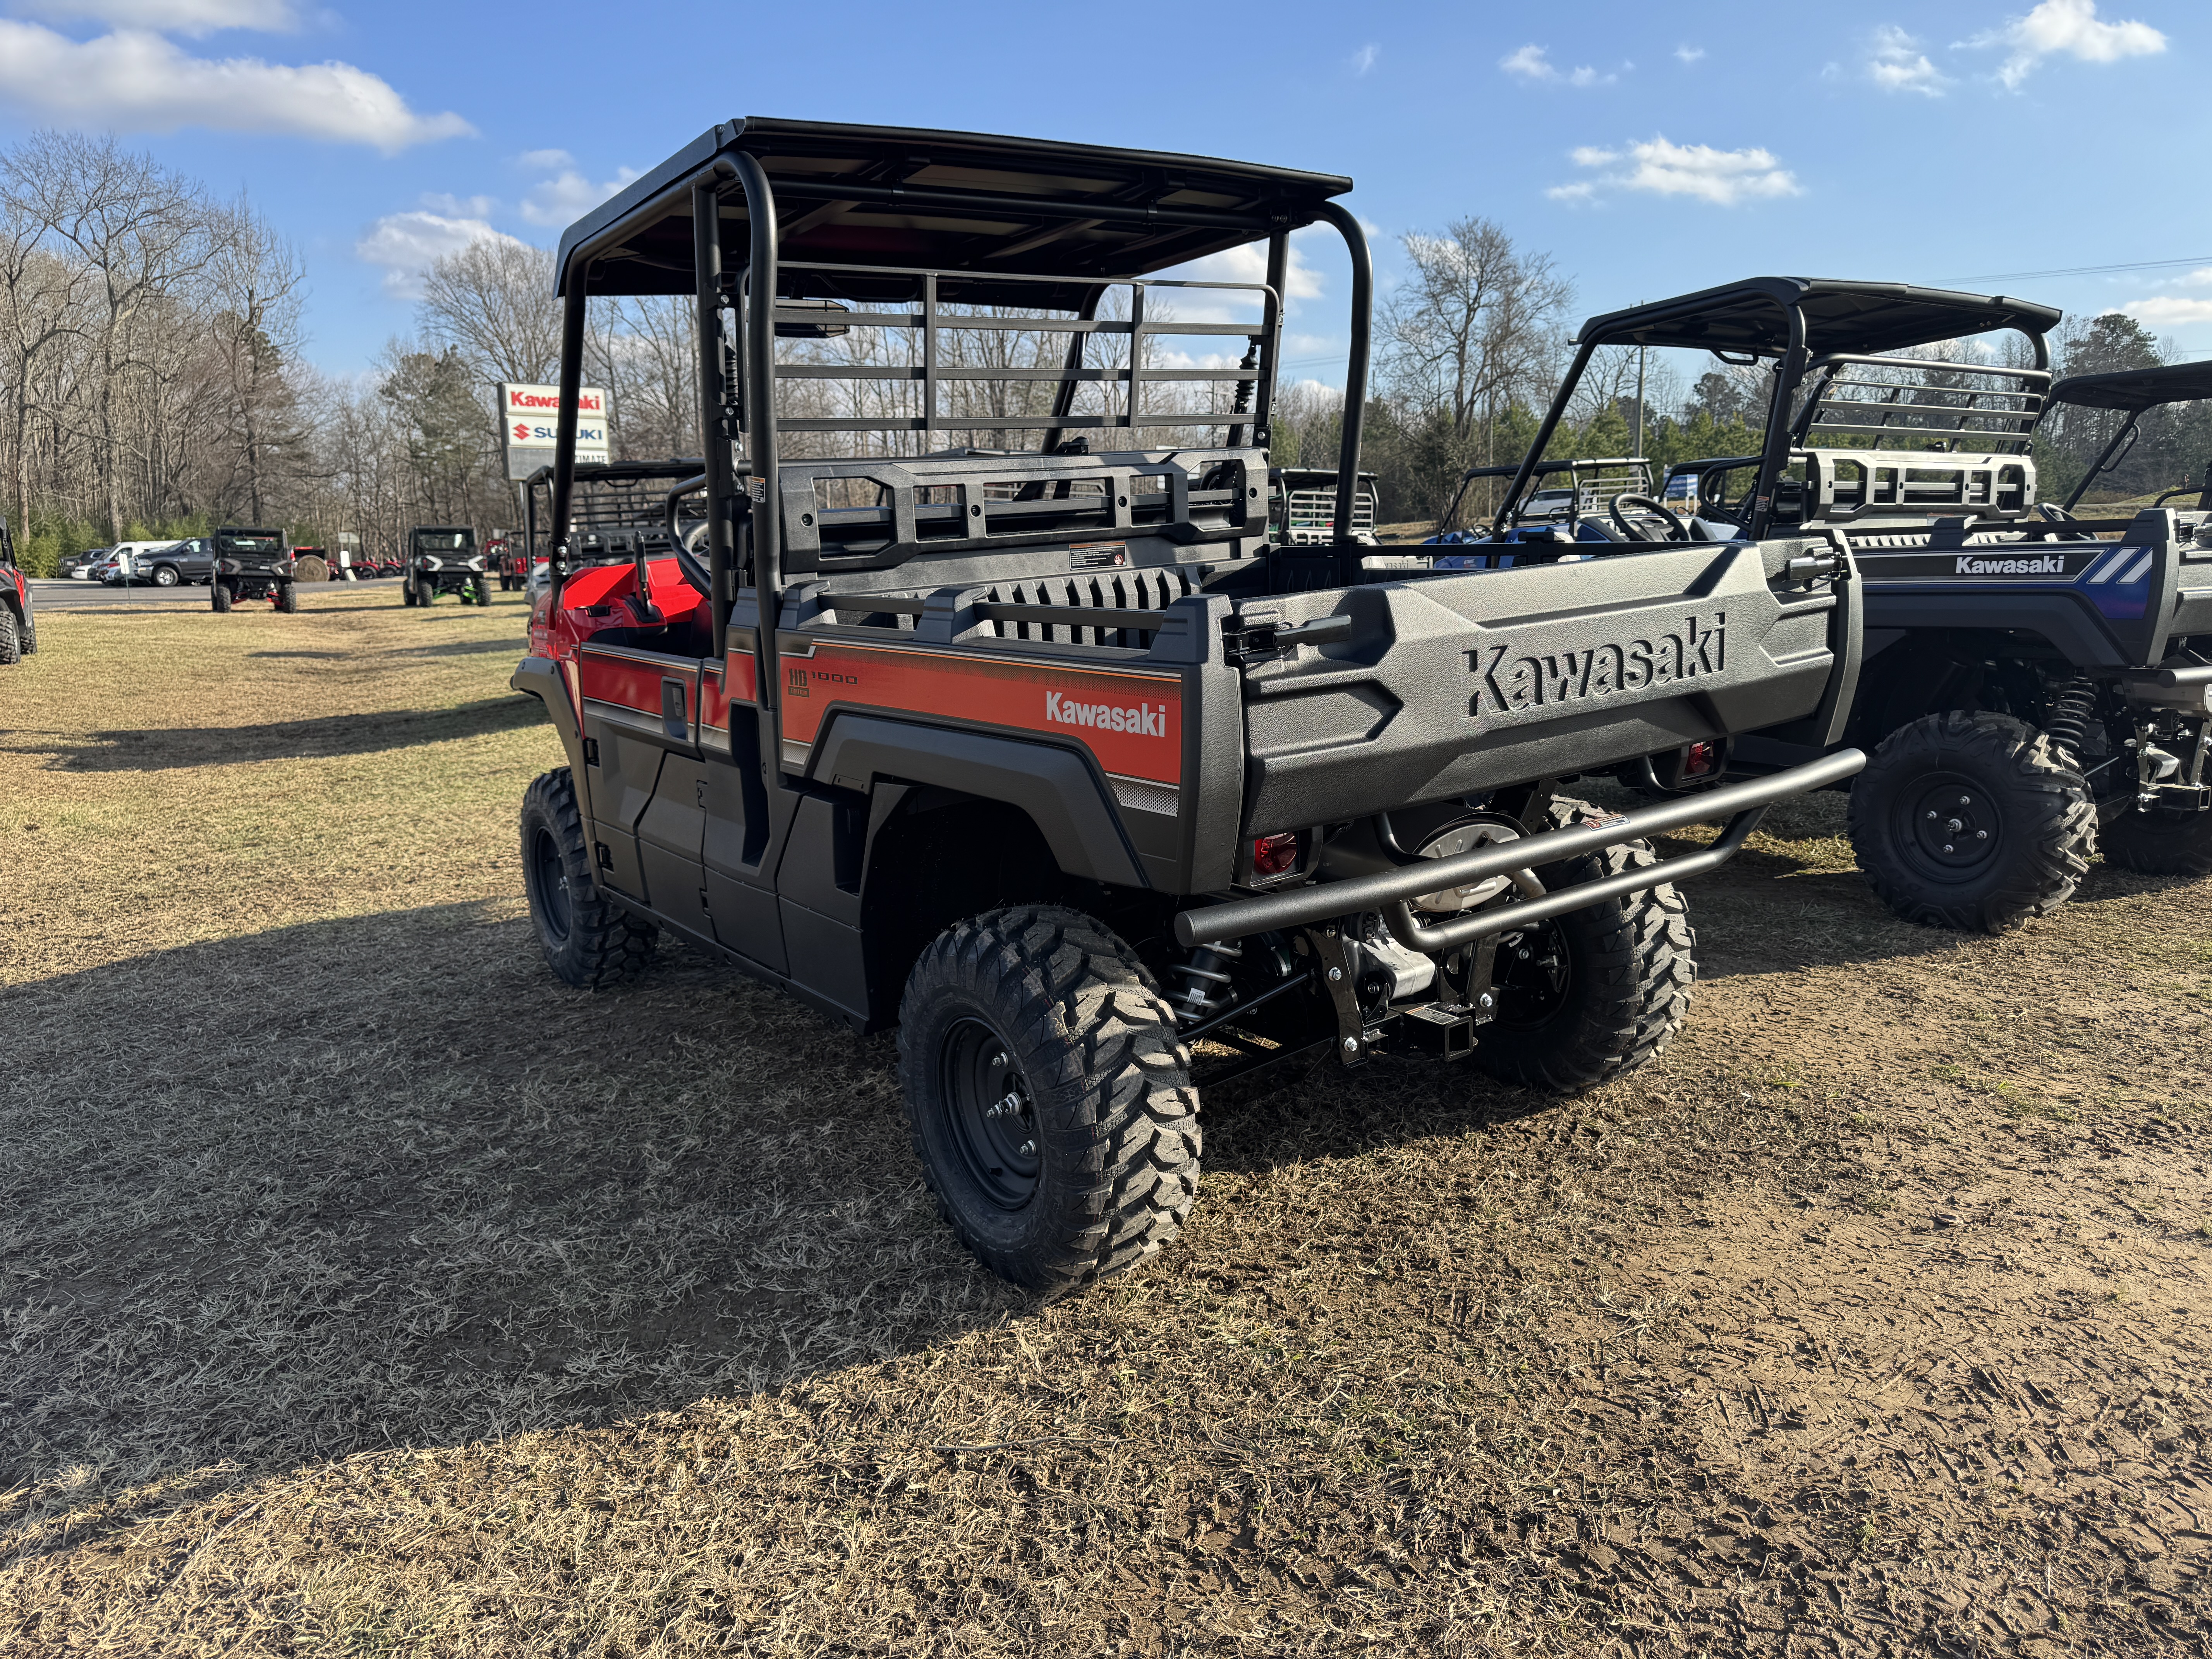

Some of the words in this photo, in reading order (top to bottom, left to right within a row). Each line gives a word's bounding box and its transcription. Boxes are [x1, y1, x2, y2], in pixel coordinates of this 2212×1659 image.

[510, 391, 600, 410] Kawaaki
[534, 427, 602, 440] SUUKI
[575, 455, 605, 464] TIMATE
[1956, 555, 2064, 574] Kawasaki
[1462, 612, 1726, 719] Kawasaki
[789, 668, 807, 687] HD
[812, 671, 857, 684] 1000
[1046, 691, 1165, 737] Kawasaki
